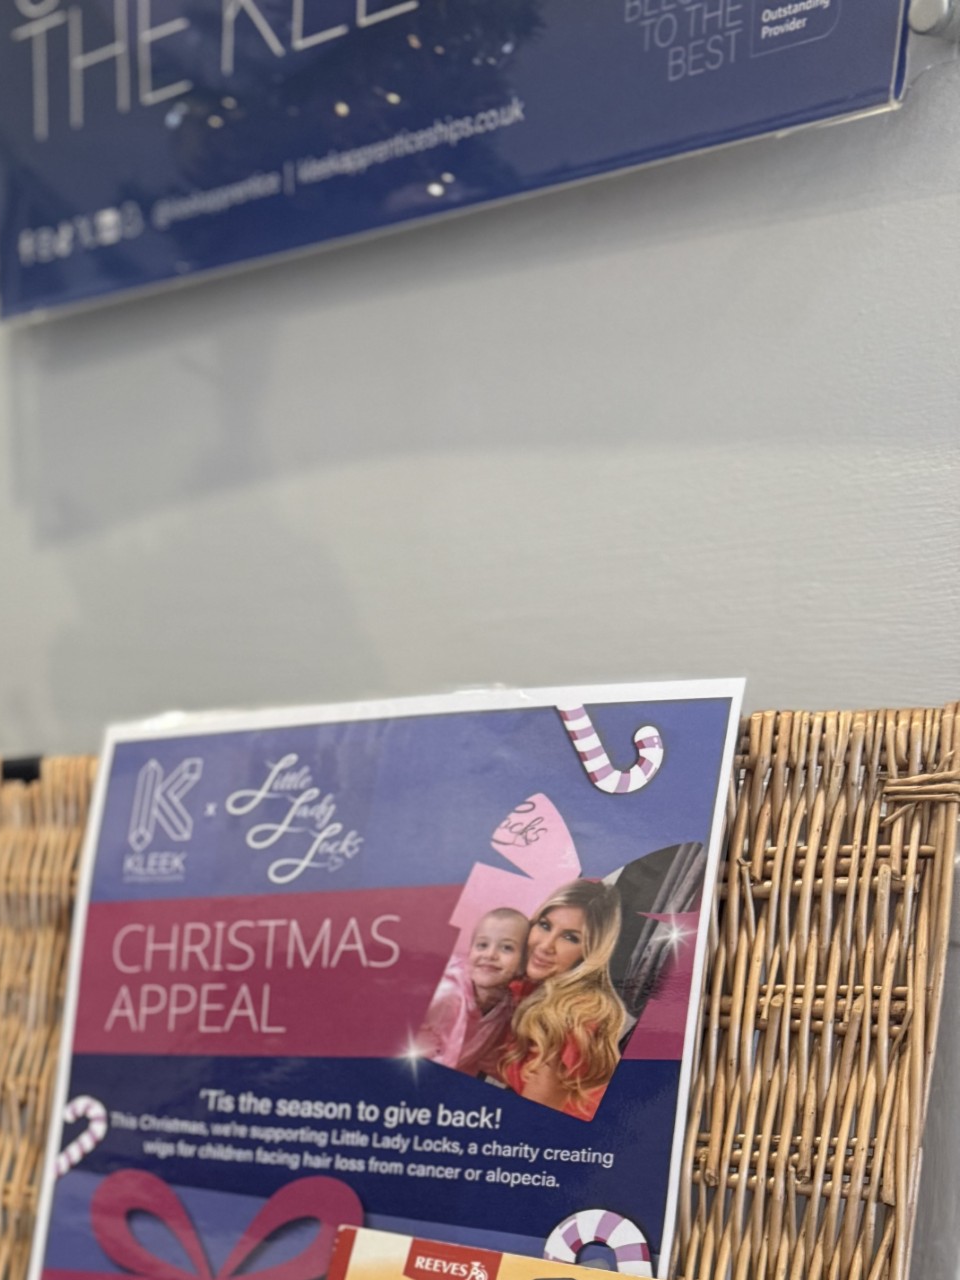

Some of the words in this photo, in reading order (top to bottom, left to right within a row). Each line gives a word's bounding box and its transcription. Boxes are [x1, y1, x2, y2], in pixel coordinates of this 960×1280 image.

[640, 13, 677, 51] TO
[684, 0, 743, 37] THE
[761, 17, 808, 40] Provider
[762, 0, 830, 23] Outstanding
[10, 0, 193, 141] THE
[668, 29, 743, 82] BEST
[225, 753, 312, 815] Little
[246, 788, 336, 849] Lady
[123, 852, 186, 875] KLEEK
[268, 823, 364, 884] Locks
[112, 914, 400, 974] CHRISTMAS
[104, 983, 286, 1033] APPEAL
[238, 1092, 272, 1116] the
[275, 1098, 351, 1121] season
[357, 1101, 380, 1122] to
[384, 1101, 431, 1129] give
[437, 1103, 502, 1129] back!
[110, 1111, 137, 1129] This
[139, 1114, 209, 1136] Christmas,
[249, 1124, 328, 1147] supporting
[331, 1129, 369, 1147] Little
[372, 1133, 410, 1153] Lady
[413, 1136, 464, 1155] Locks,
[467, 1142, 478, 1154] a
[482, 1141, 539, 1163] charity
[543, 1148, 615, 1168] creating
[143, 1140, 175, 1159] wigs
[177, 1141, 197, 1158] for
[198, 1143, 254, 1163] children
[255, 1147, 300, 1170] facing
[303, 1151, 332, 1168] hair
[334, 1155, 365, 1172] loss
[367, 1156, 404, 1175] from
[407, 1164, 460, 1180] cancer
[464, 1168, 483, 1181] or
[485, 1167, 560, 1187] alopecia.
[414, 1255, 468, 1277] REEVES
